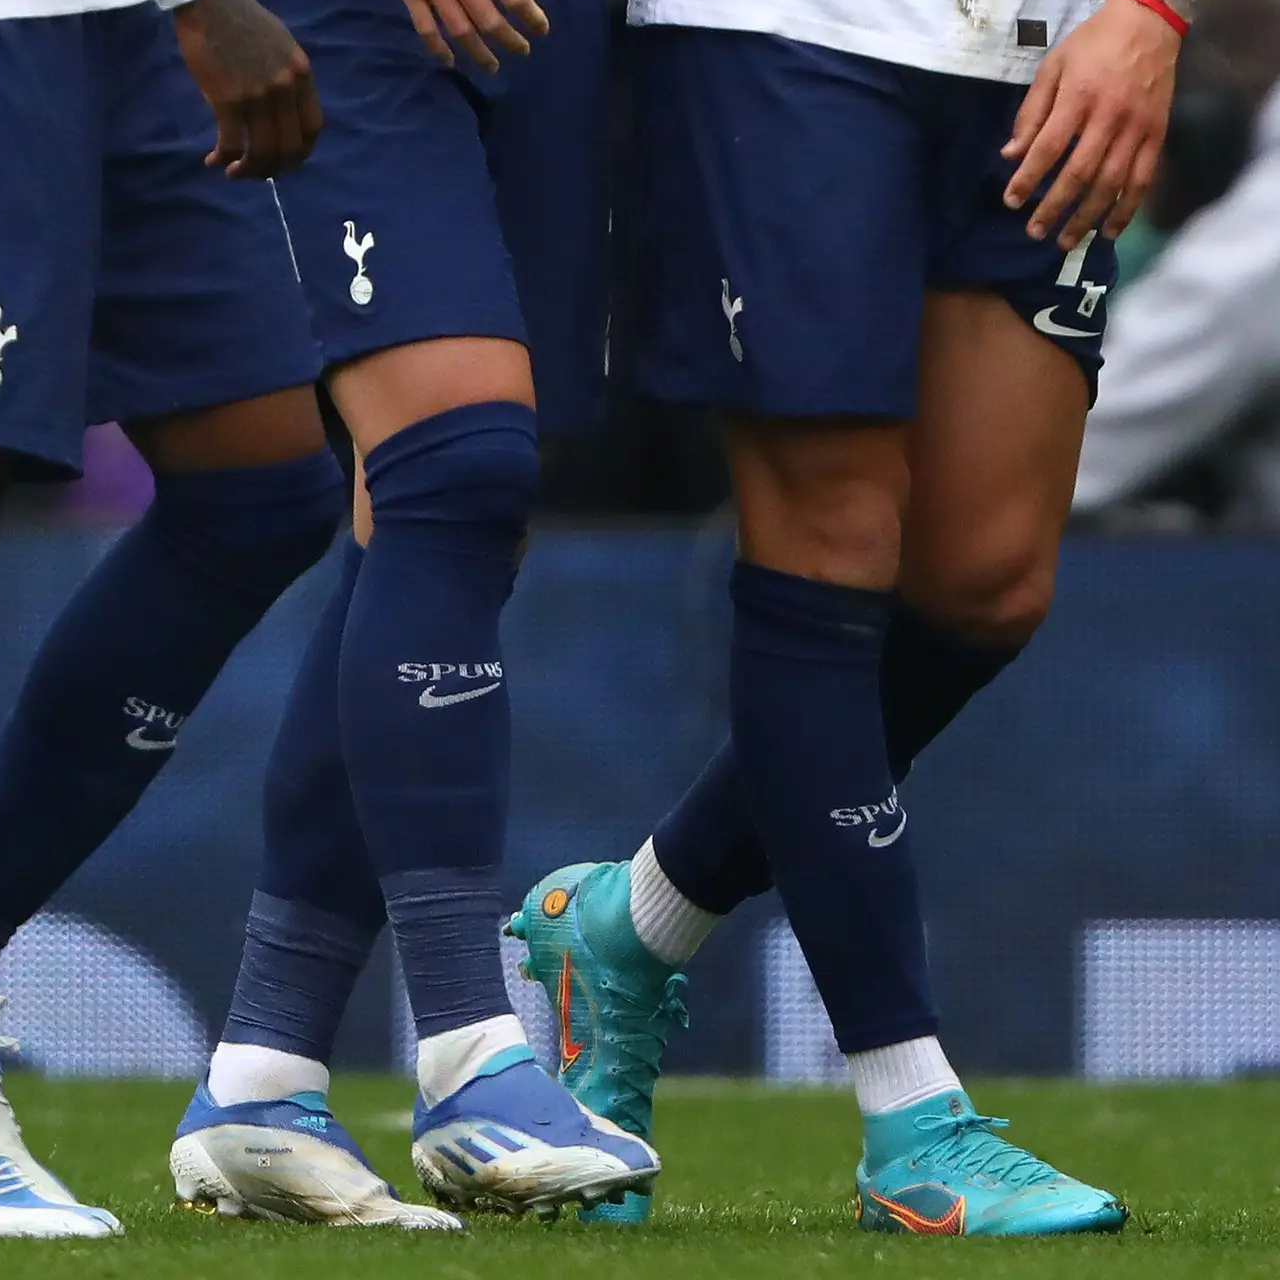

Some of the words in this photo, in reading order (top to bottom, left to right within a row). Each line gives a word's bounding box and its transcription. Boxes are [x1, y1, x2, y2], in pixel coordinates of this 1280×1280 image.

[398, 661, 503, 682] SPURS
[122, 696, 184, 728] SPU
[830, 790, 898, 826] SPU
